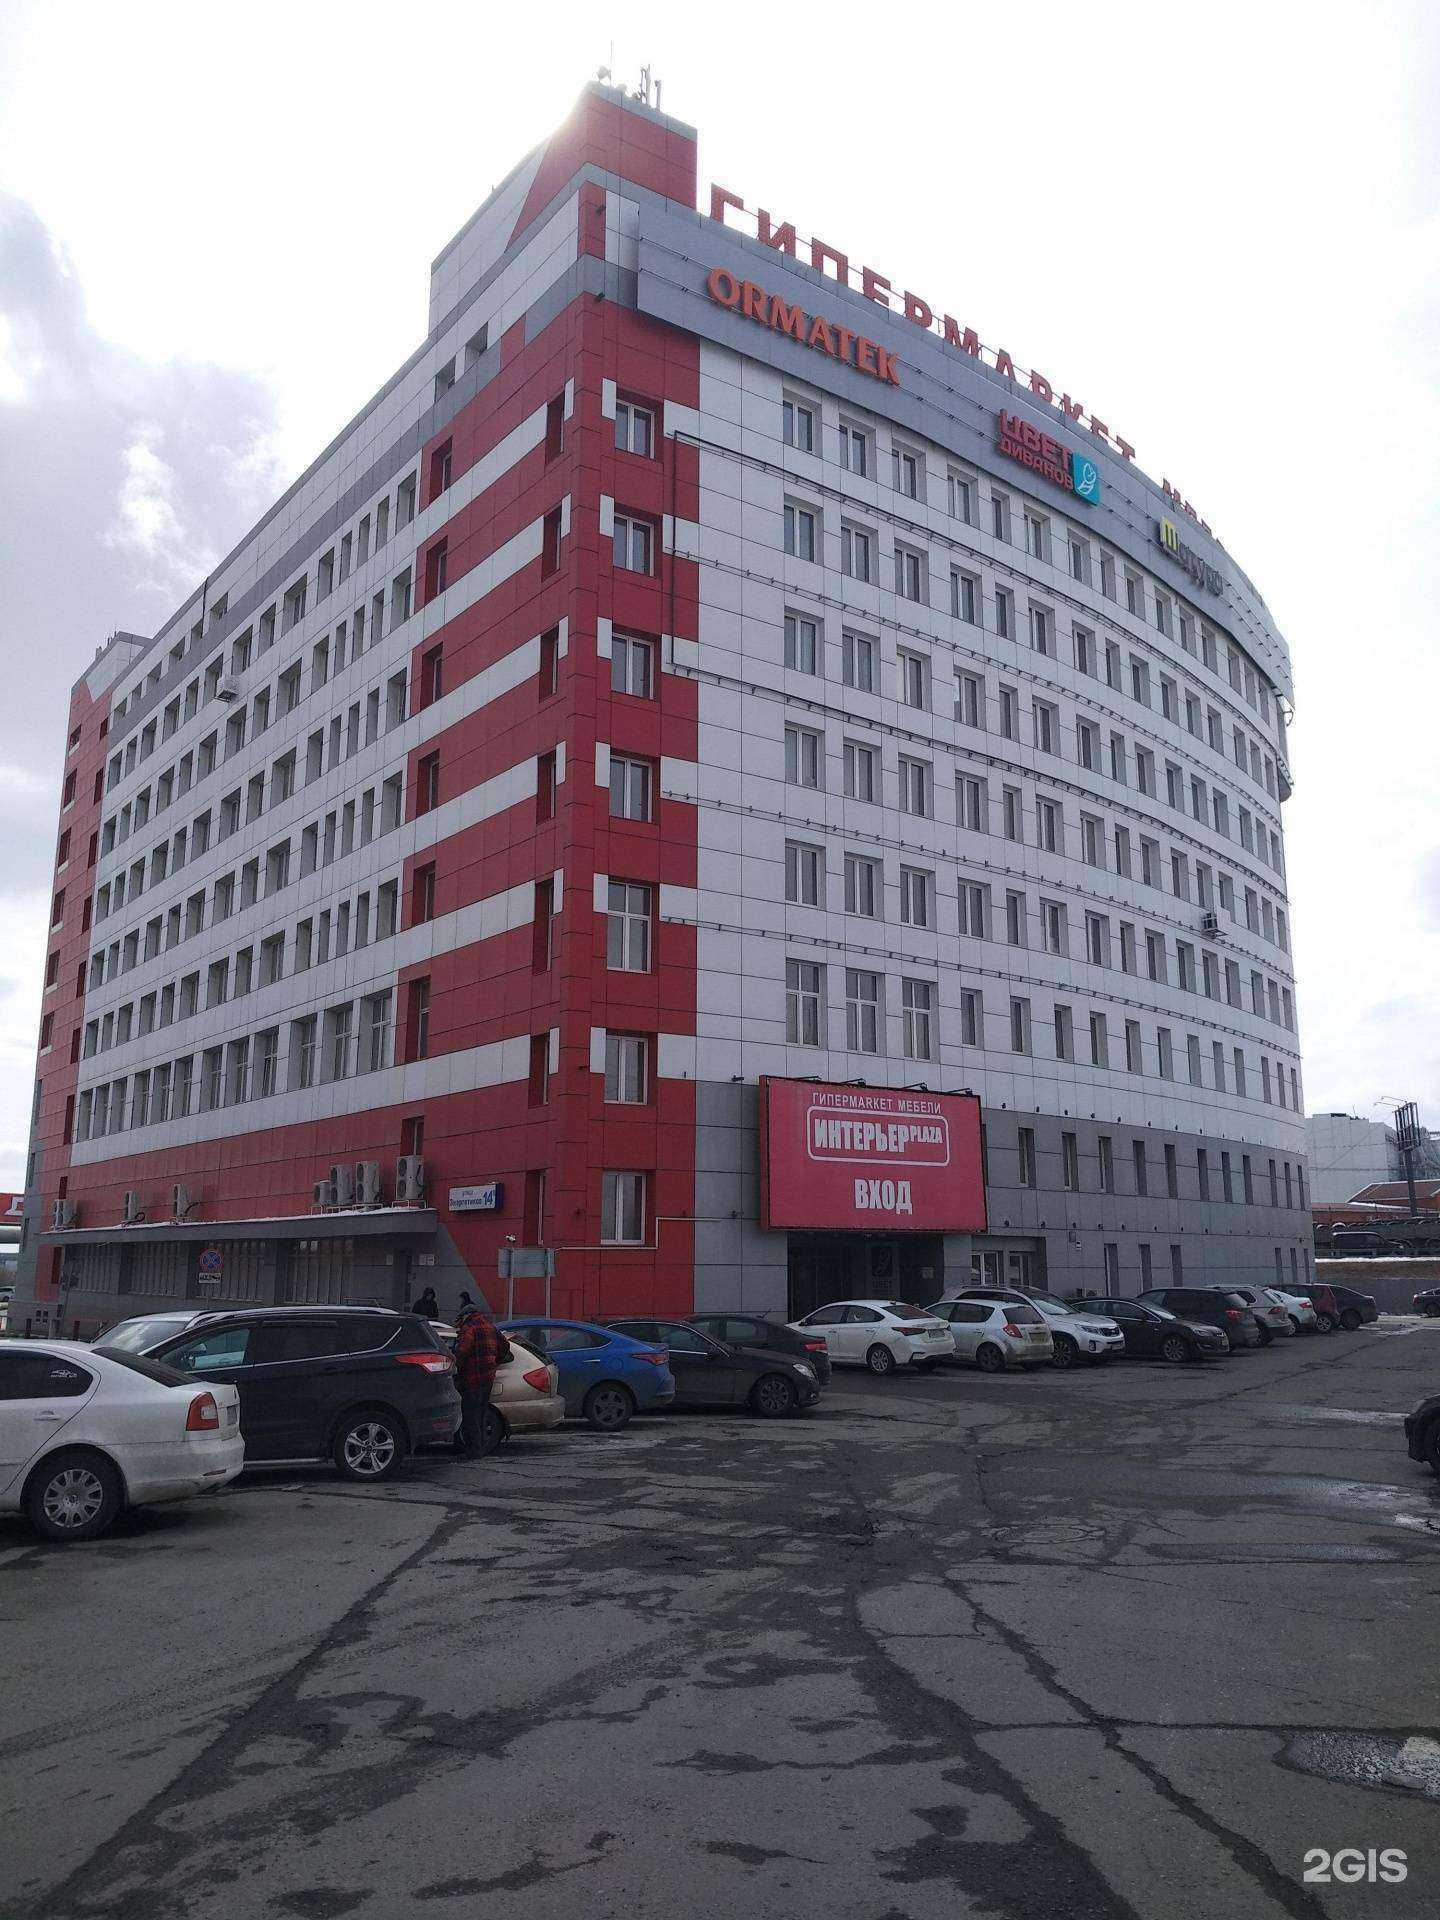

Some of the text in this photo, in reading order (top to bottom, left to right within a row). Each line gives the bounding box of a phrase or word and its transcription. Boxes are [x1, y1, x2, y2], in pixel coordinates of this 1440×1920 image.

[707, 267, 901, 386] ORMATEK
[1000, 408, 1073, 471] ЦВЕТ
[1000, 435, 1074, 491] ДИВАНОВ
[897, 1099, 942, 1114] МЕБЕЛИ
[813, 1118, 943, 1153] ИНТЕРЬЕР PLAZA
[853, 1178, 914, 1215] ВХОД
